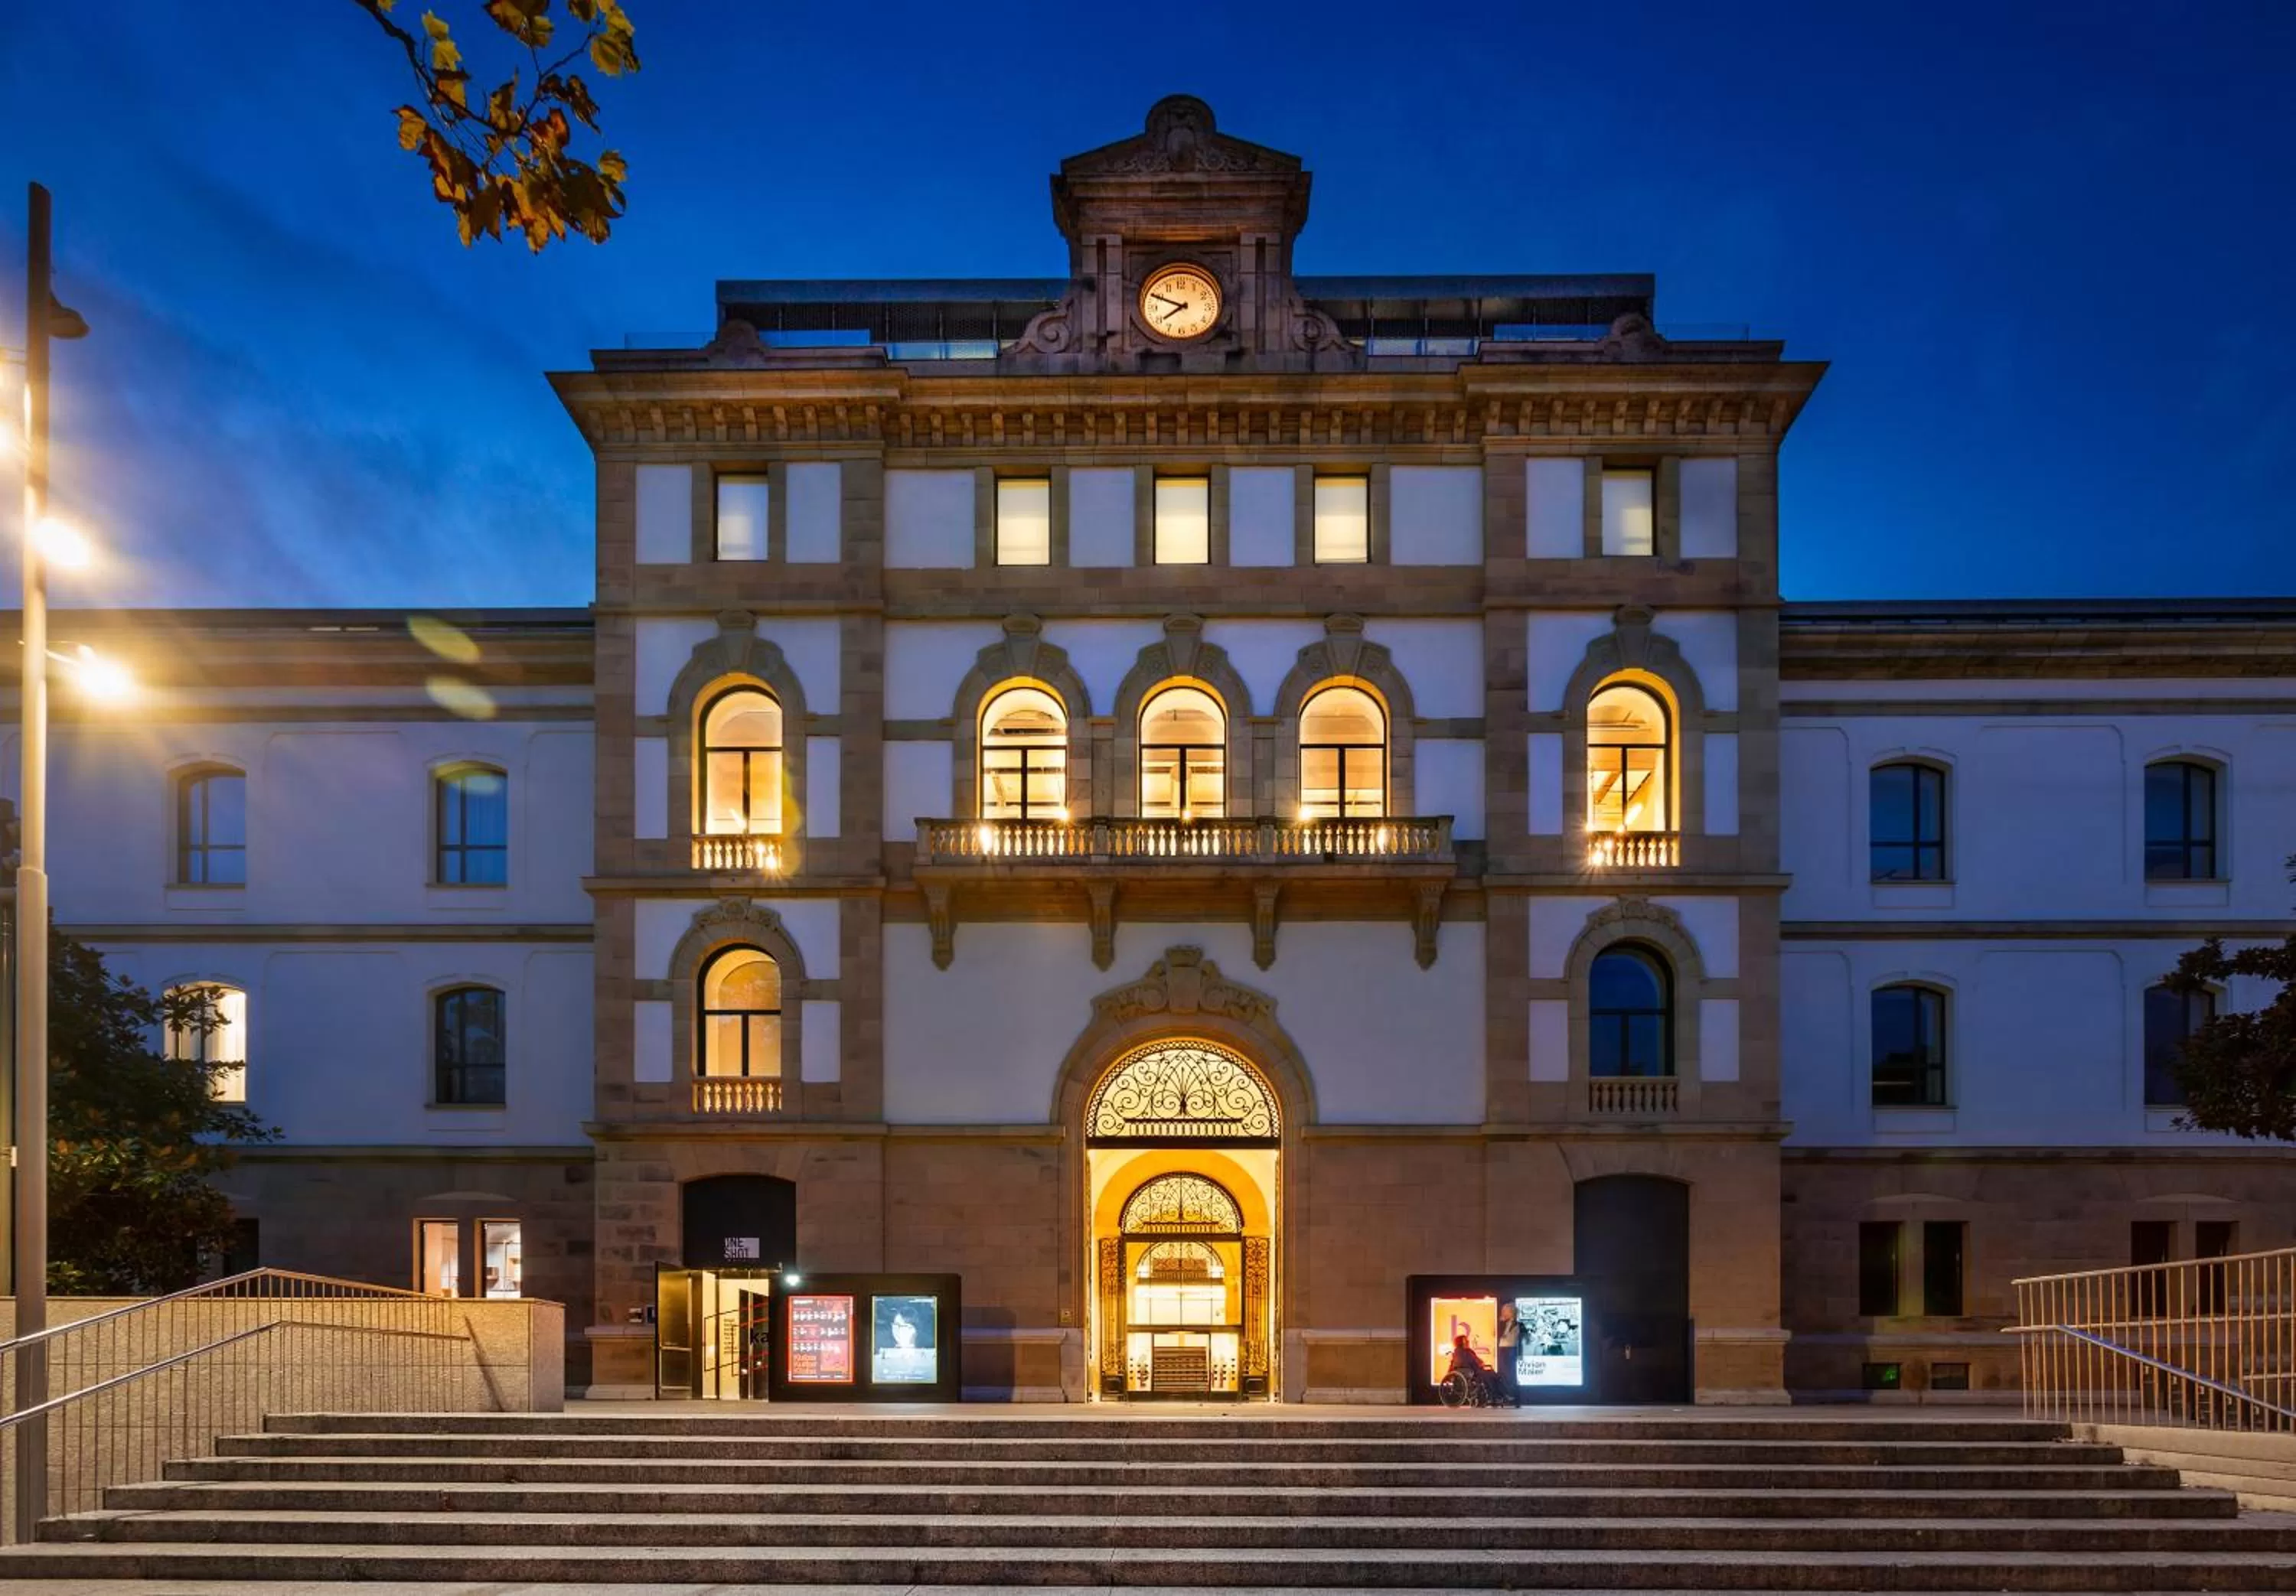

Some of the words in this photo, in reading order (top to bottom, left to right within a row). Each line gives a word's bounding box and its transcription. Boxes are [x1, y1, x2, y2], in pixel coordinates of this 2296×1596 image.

[1166, 284, 1172, 292] 11
[1176, 281, 1186, 290] 12
[1200, 291, 1207, 301] 2
